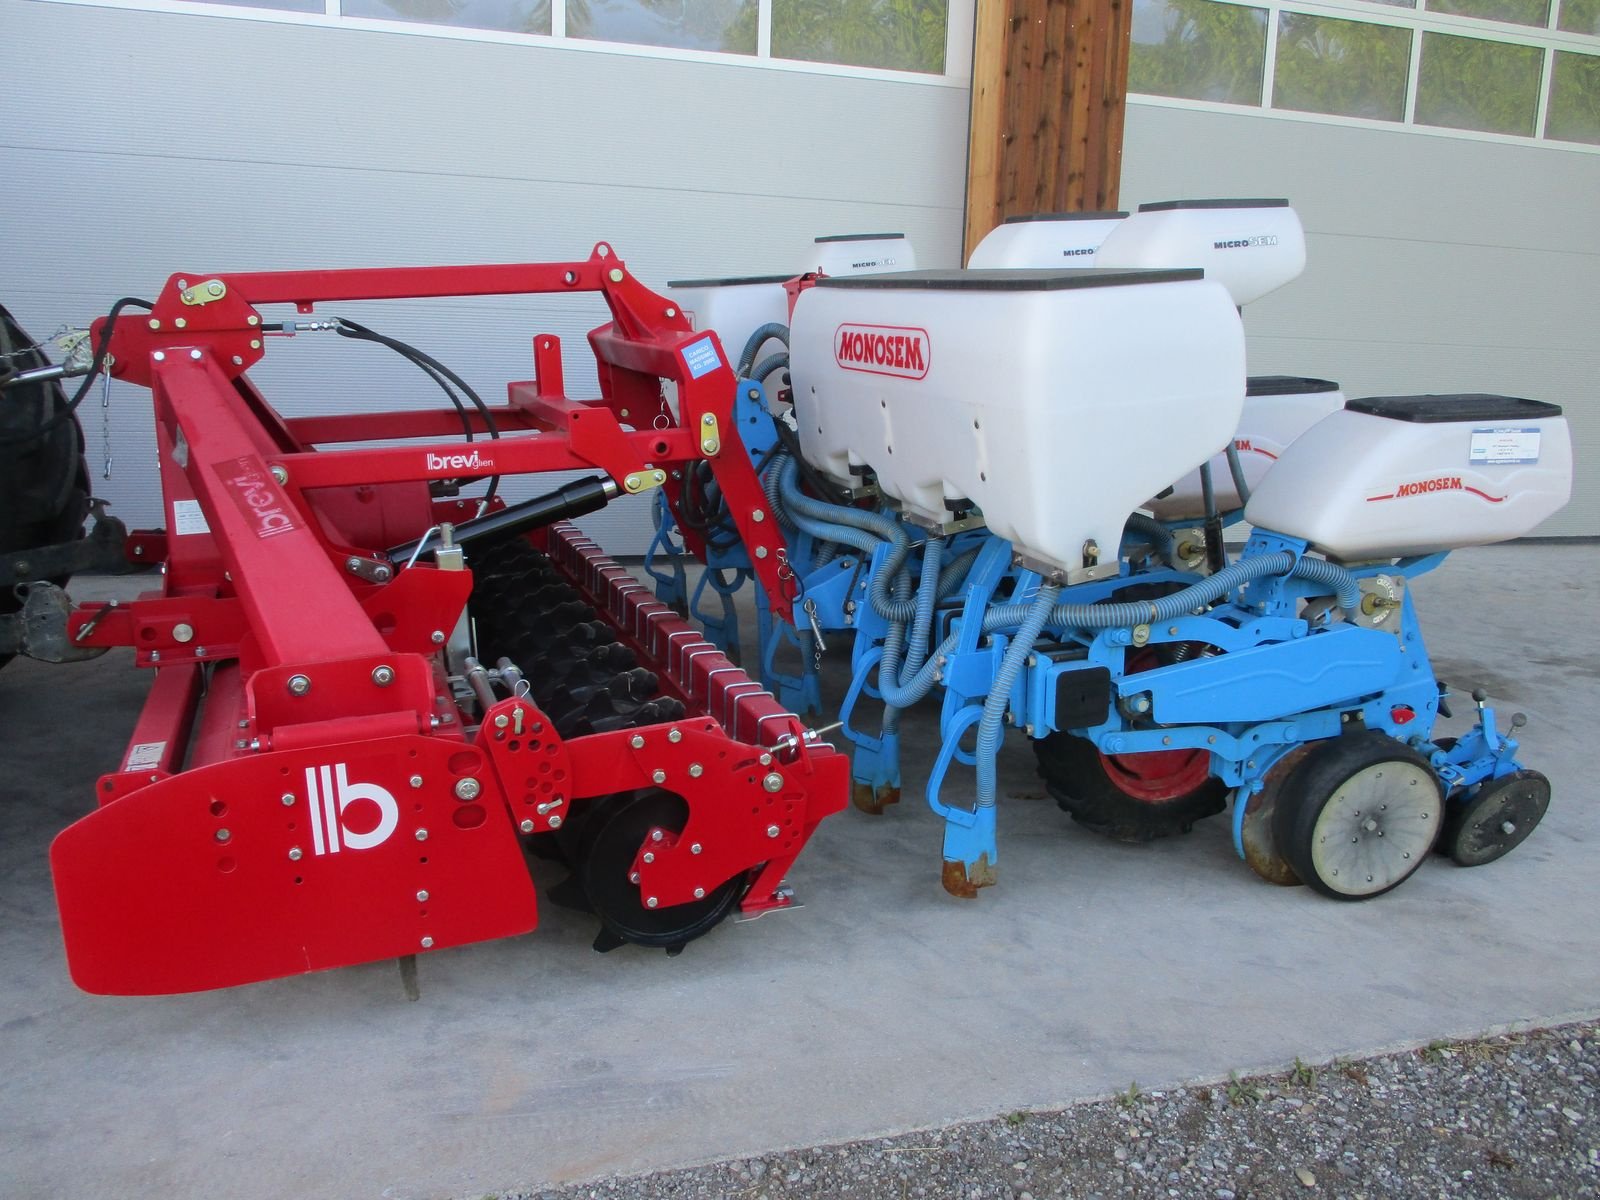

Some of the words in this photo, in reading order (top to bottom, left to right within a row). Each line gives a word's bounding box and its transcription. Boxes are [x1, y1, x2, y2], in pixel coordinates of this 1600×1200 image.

[1213, 234, 1278, 249] MICROSEM
[1063, 246, 1098, 257] MICRO
[838, 331, 925, 371] MONOSEM
[1396, 477, 1463, 497] MONOSEM
